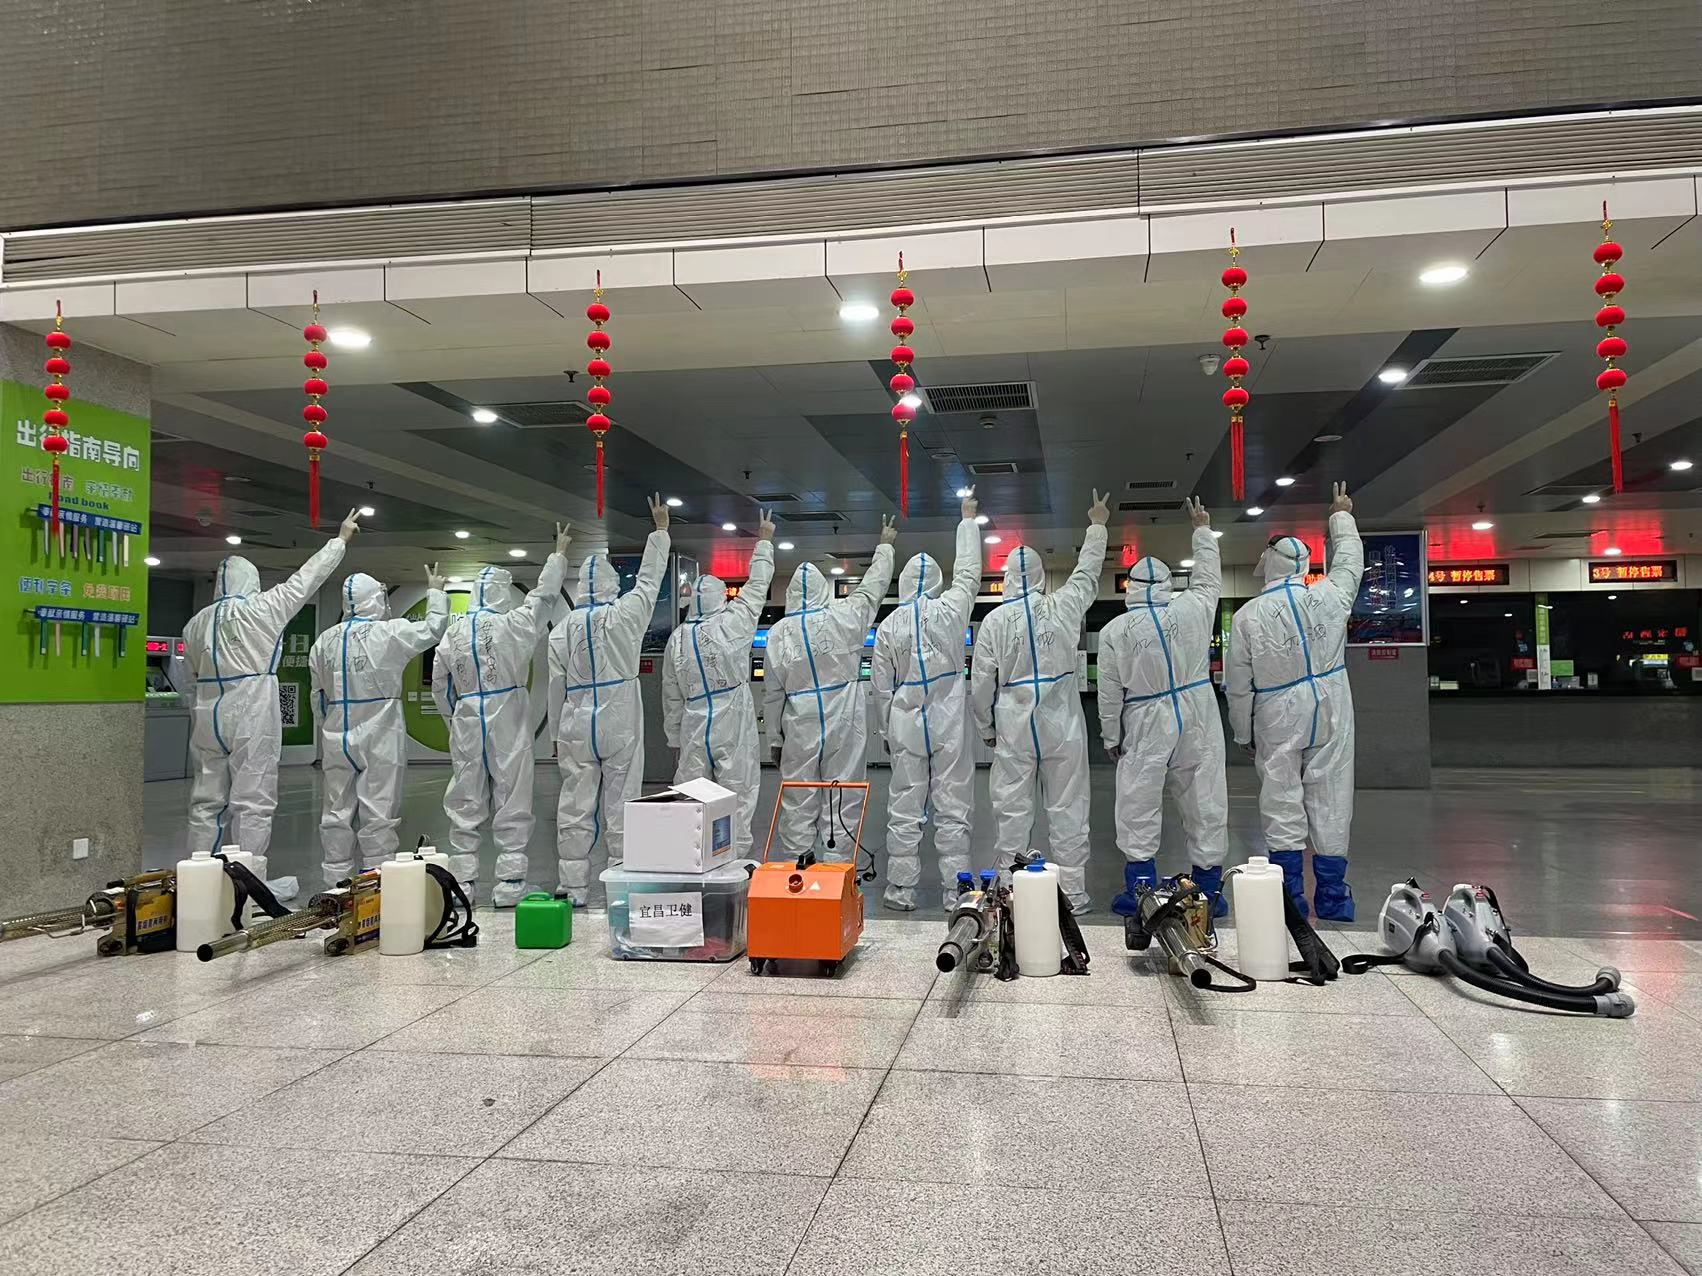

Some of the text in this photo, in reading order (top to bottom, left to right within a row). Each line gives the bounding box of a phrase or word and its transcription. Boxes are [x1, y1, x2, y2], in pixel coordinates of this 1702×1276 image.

[21, 466, 74, 492] 出行南
[81, 498, 110, 511] book
[1450, 569, 1496, 582] 暂停售票
[1616, 565, 1663, 578] 暂停售票
[639, 902, 693, 919] 宜昌卫健
